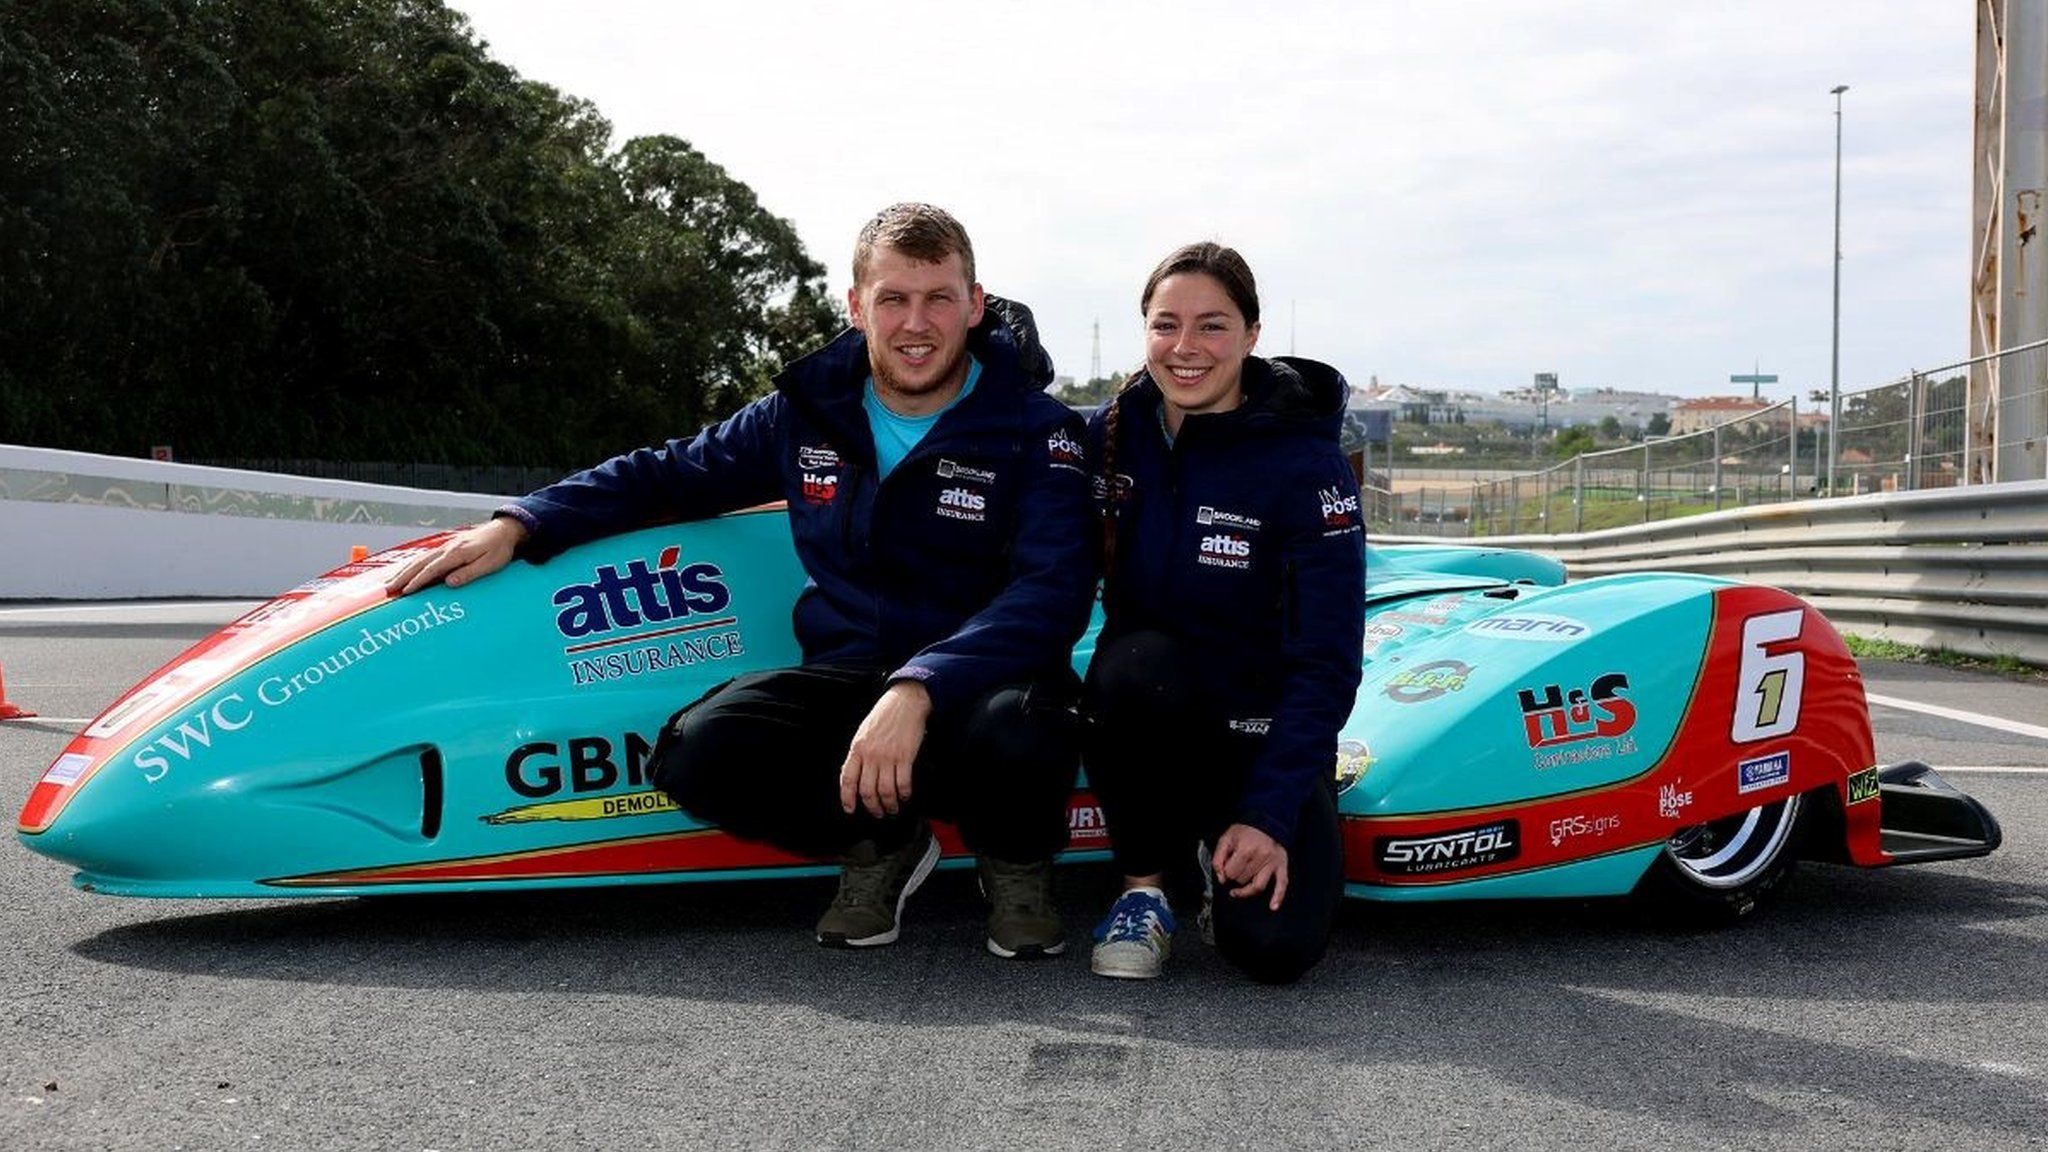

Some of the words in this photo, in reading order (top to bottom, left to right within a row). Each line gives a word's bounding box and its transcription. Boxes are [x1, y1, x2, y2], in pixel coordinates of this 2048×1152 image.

[939, 487, 985, 510] attis
[1322, 496, 1358, 518] POSE
[936, 507, 985, 521] INSURANCE
[1200, 532, 1250, 557] attis
[1198, 555, 1250, 569] INSURANCE
[553, 545, 731, 638] attis
[1471, 618, 1585, 636] marin
[571, 633, 744, 686] INSURANCE
[1732, 608, 1806, 744] 6
[133, 693, 254, 784] SWC
[258, 597, 466, 707] Groundworks
[1755, 669, 1787, 728] 1
[1517, 672, 1638, 750] H&S
[603, 794, 676, 815] DEMOLI
[1383, 831, 1513, 862] SYNTOL
[1406, 853, 1496, 872] LUBRICANTS
